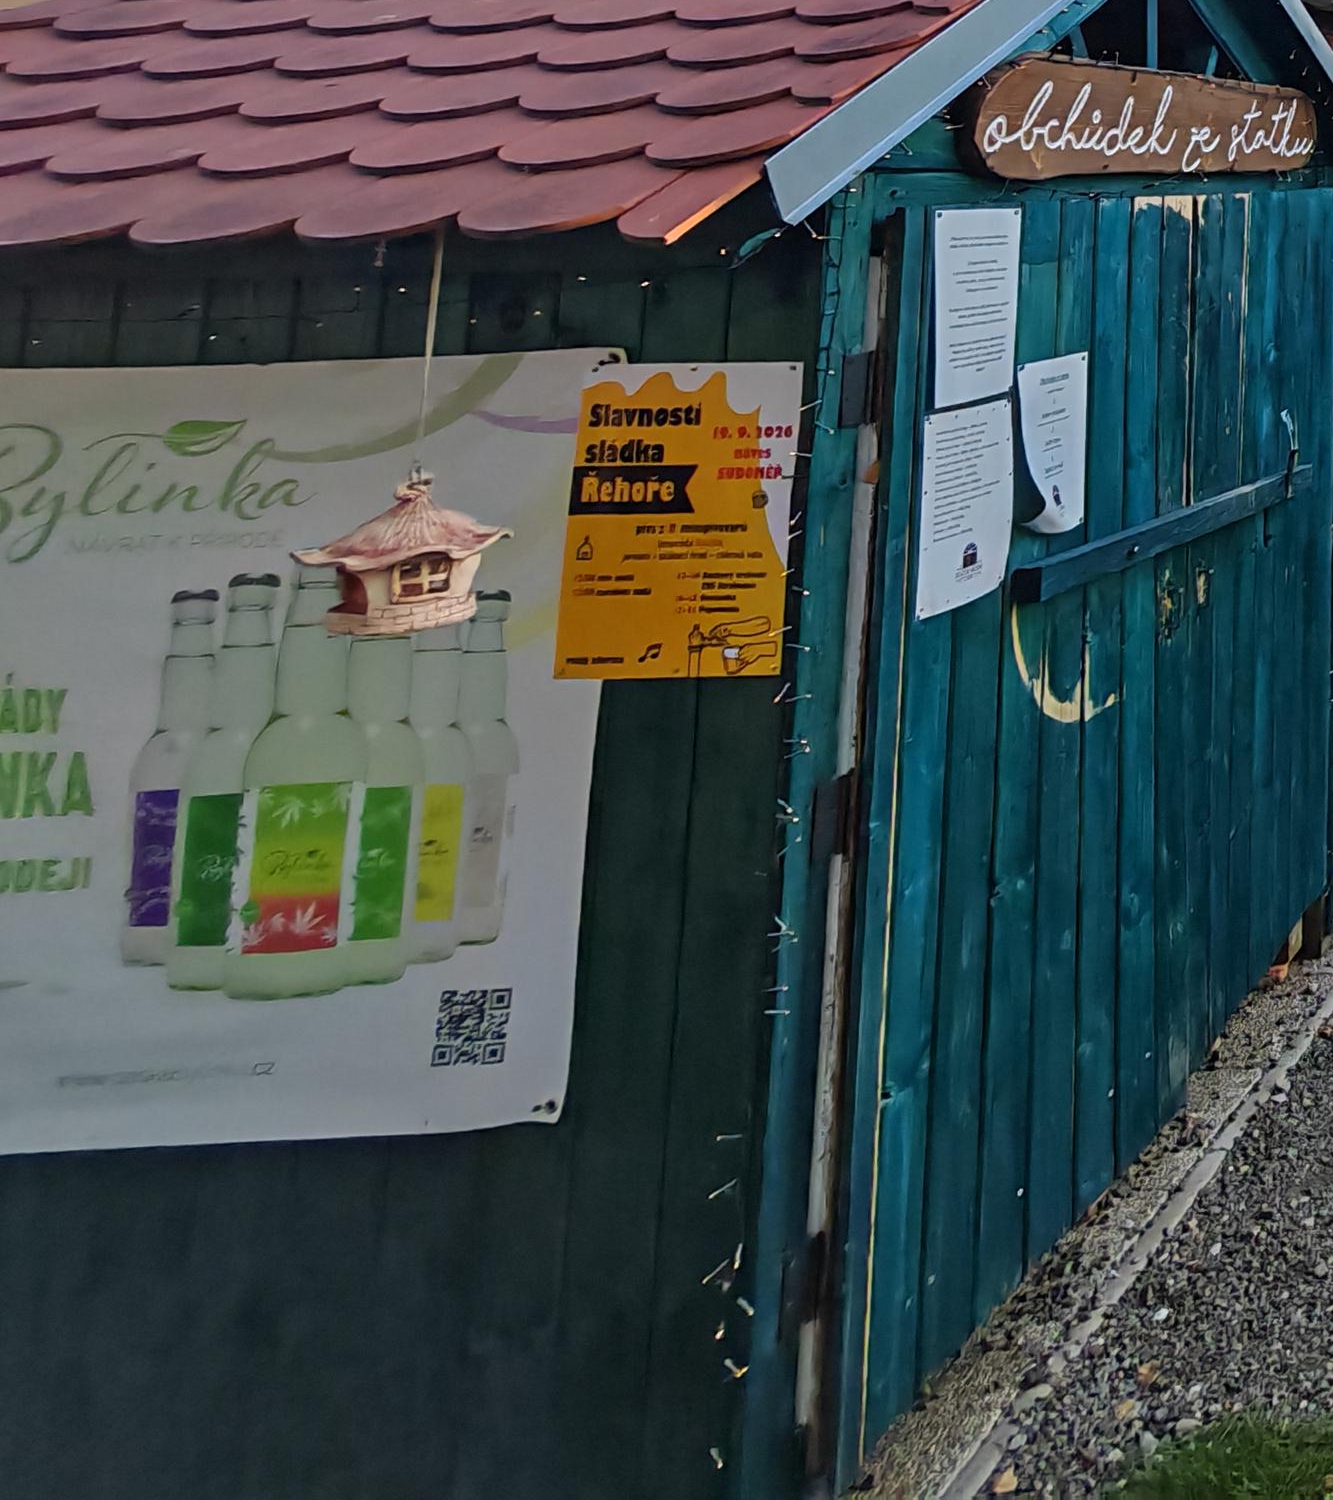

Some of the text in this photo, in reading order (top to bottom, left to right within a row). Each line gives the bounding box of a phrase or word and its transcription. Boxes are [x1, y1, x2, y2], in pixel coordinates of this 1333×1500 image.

[983, 80, 1315, 173] obchůdek ze statku
[588, 403, 702, 428] Slavnosti
[585, 439, 665, 464] sládka
[580, 471, 675, 503] Řehoře
